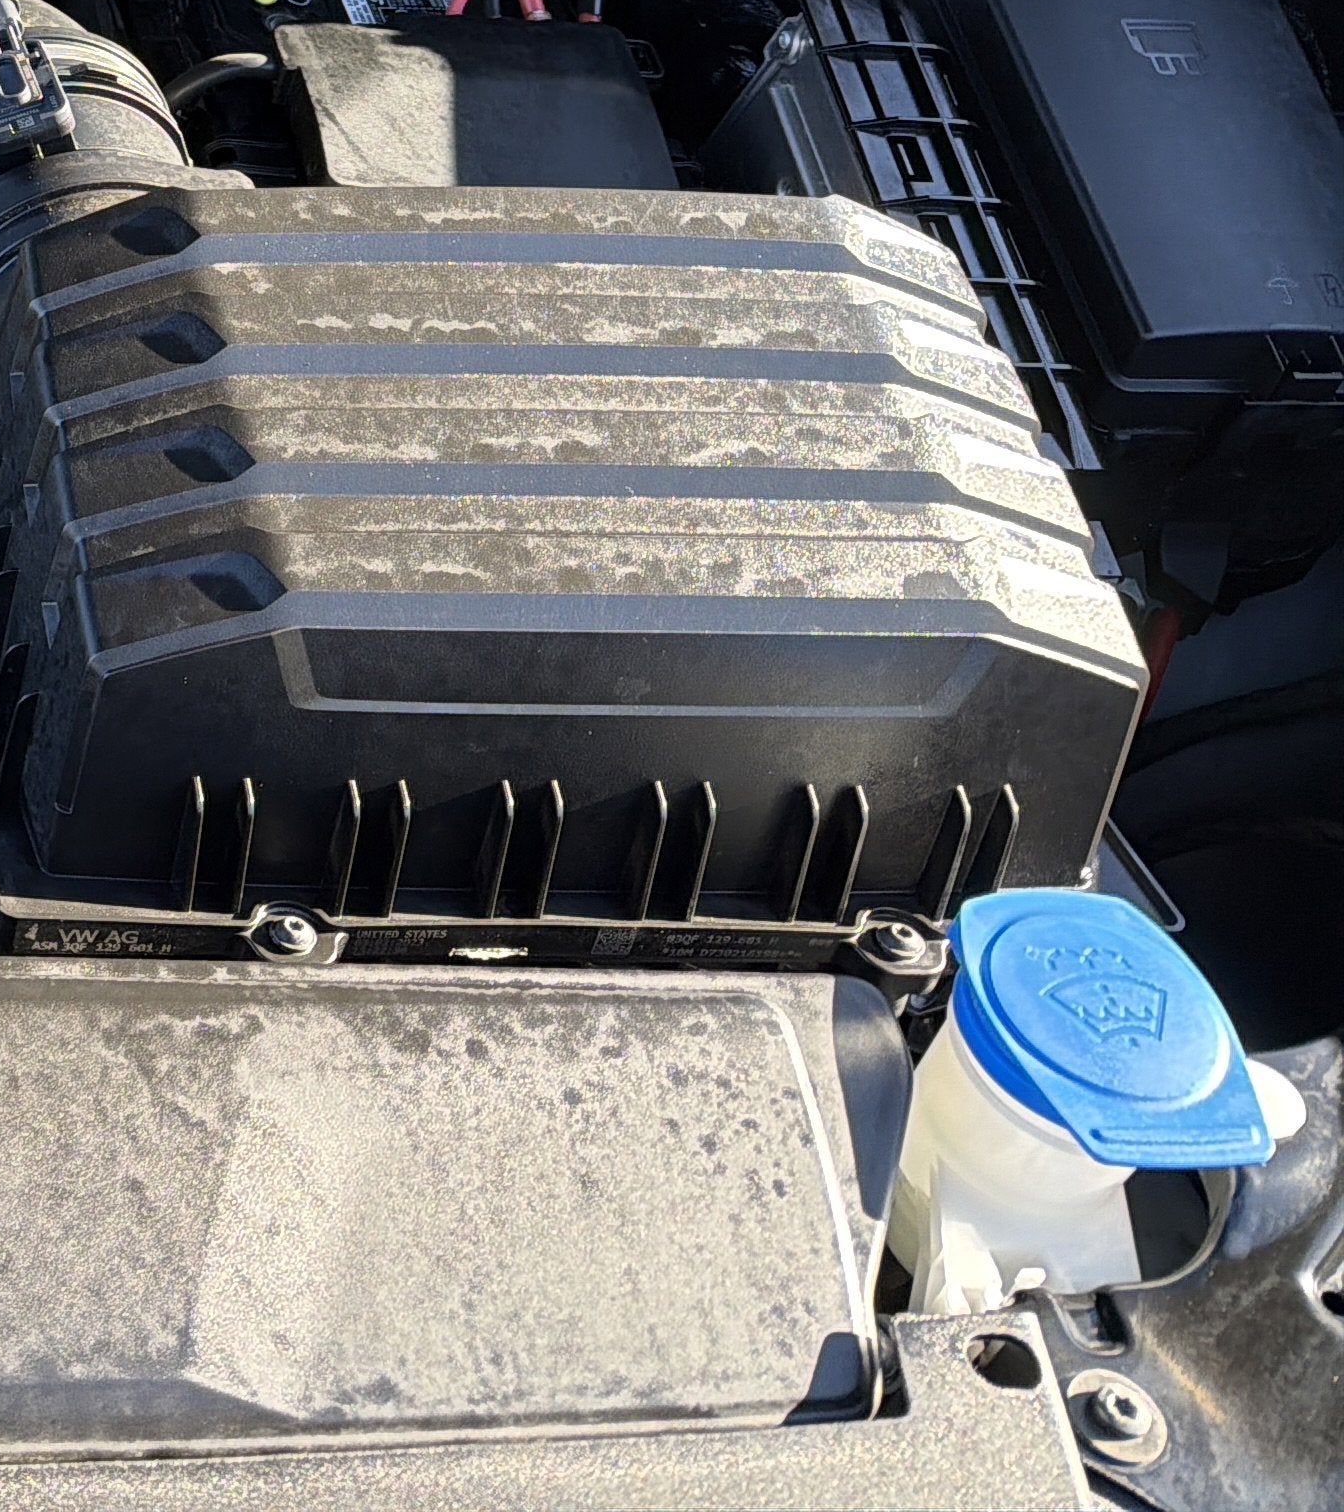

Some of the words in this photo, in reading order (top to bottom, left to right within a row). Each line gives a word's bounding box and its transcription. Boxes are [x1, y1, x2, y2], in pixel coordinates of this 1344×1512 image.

[58, 928, 99, 943] VW
[103, 930, 140, 944] AG
[356, 930, 400, 939] UNITED
[404, 929, 449, 939] STATES
[95, 943, 121, 952] 129
